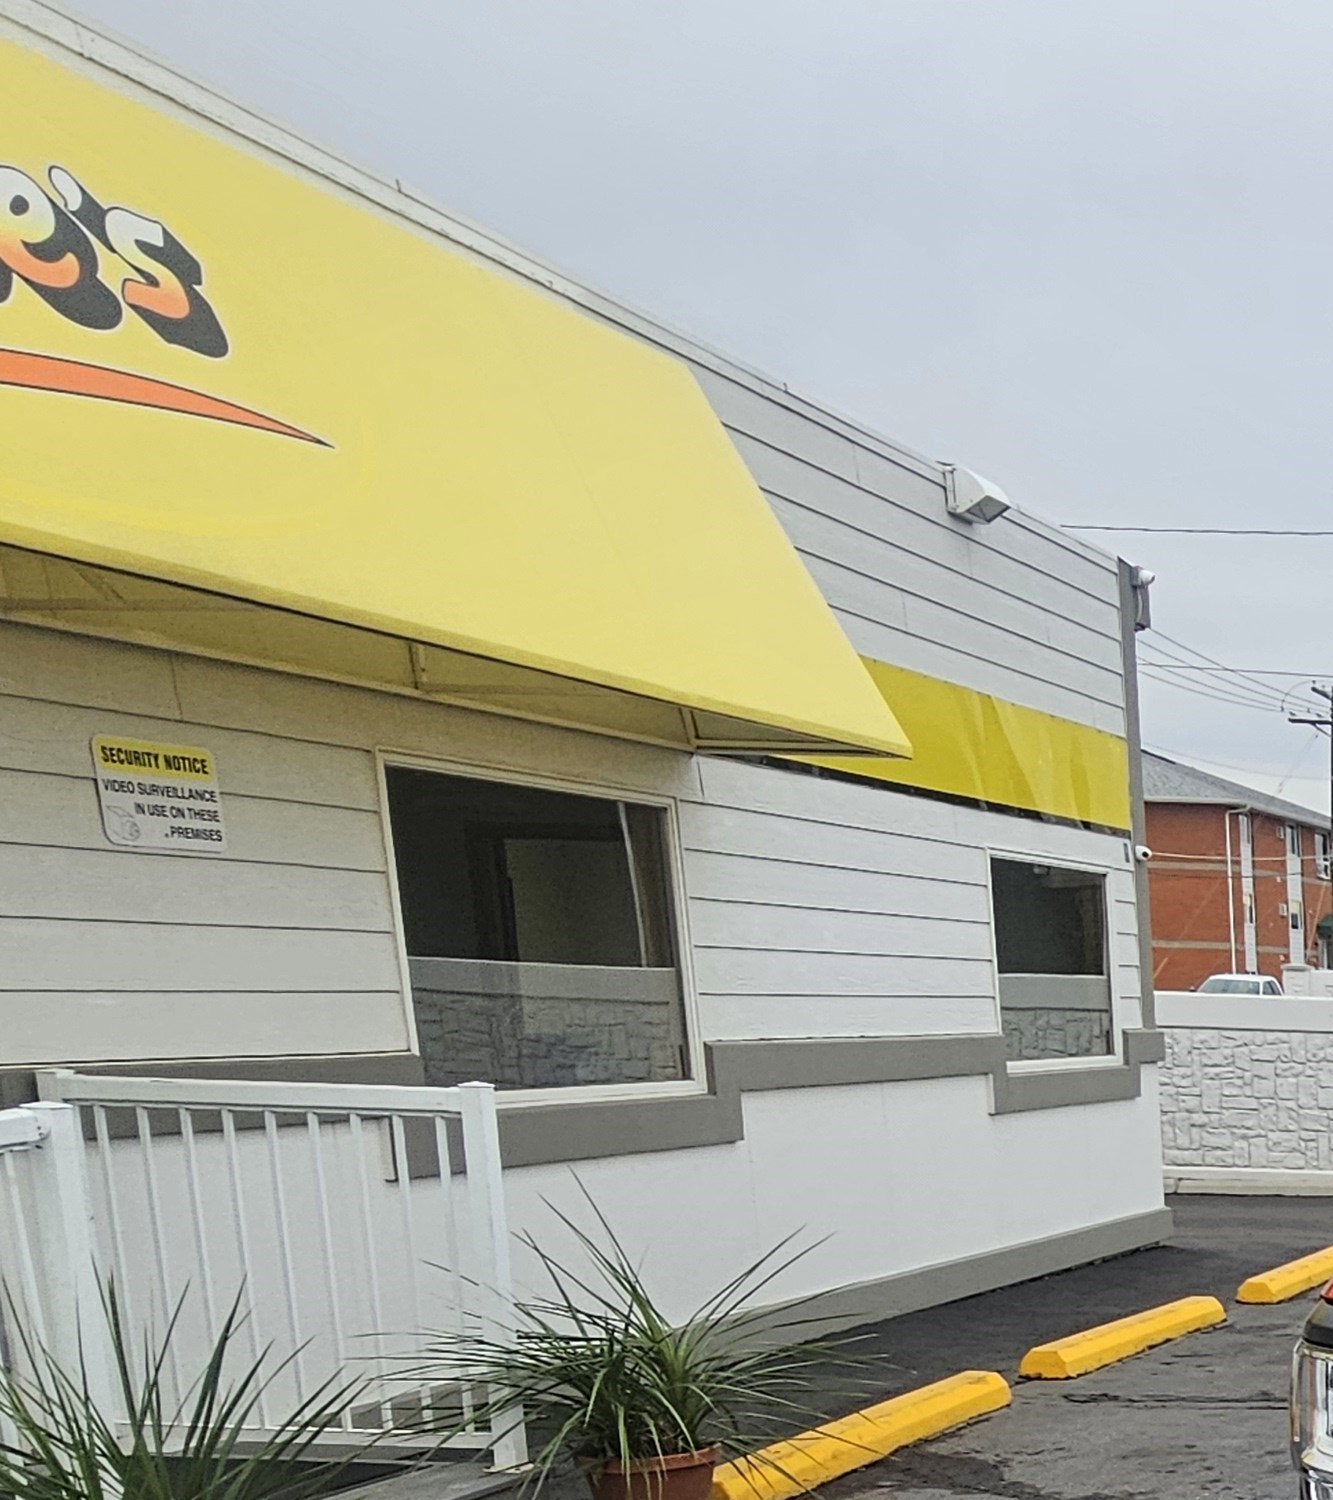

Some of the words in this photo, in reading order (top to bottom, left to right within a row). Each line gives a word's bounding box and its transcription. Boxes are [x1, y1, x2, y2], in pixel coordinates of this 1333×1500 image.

[101, 745, 159, 769] SECURITY
[164, 754, 209, 775] NOTICE
[102, 778, 135, 794] VIDEO
[138, 783, 218, 803] SURVEILLANCE
[134, 803, 145, 815] IN
[147, 804, 168, 818] USE
[170, 807, 185, 820] ON
[187, 808, 220, 823] THESE
